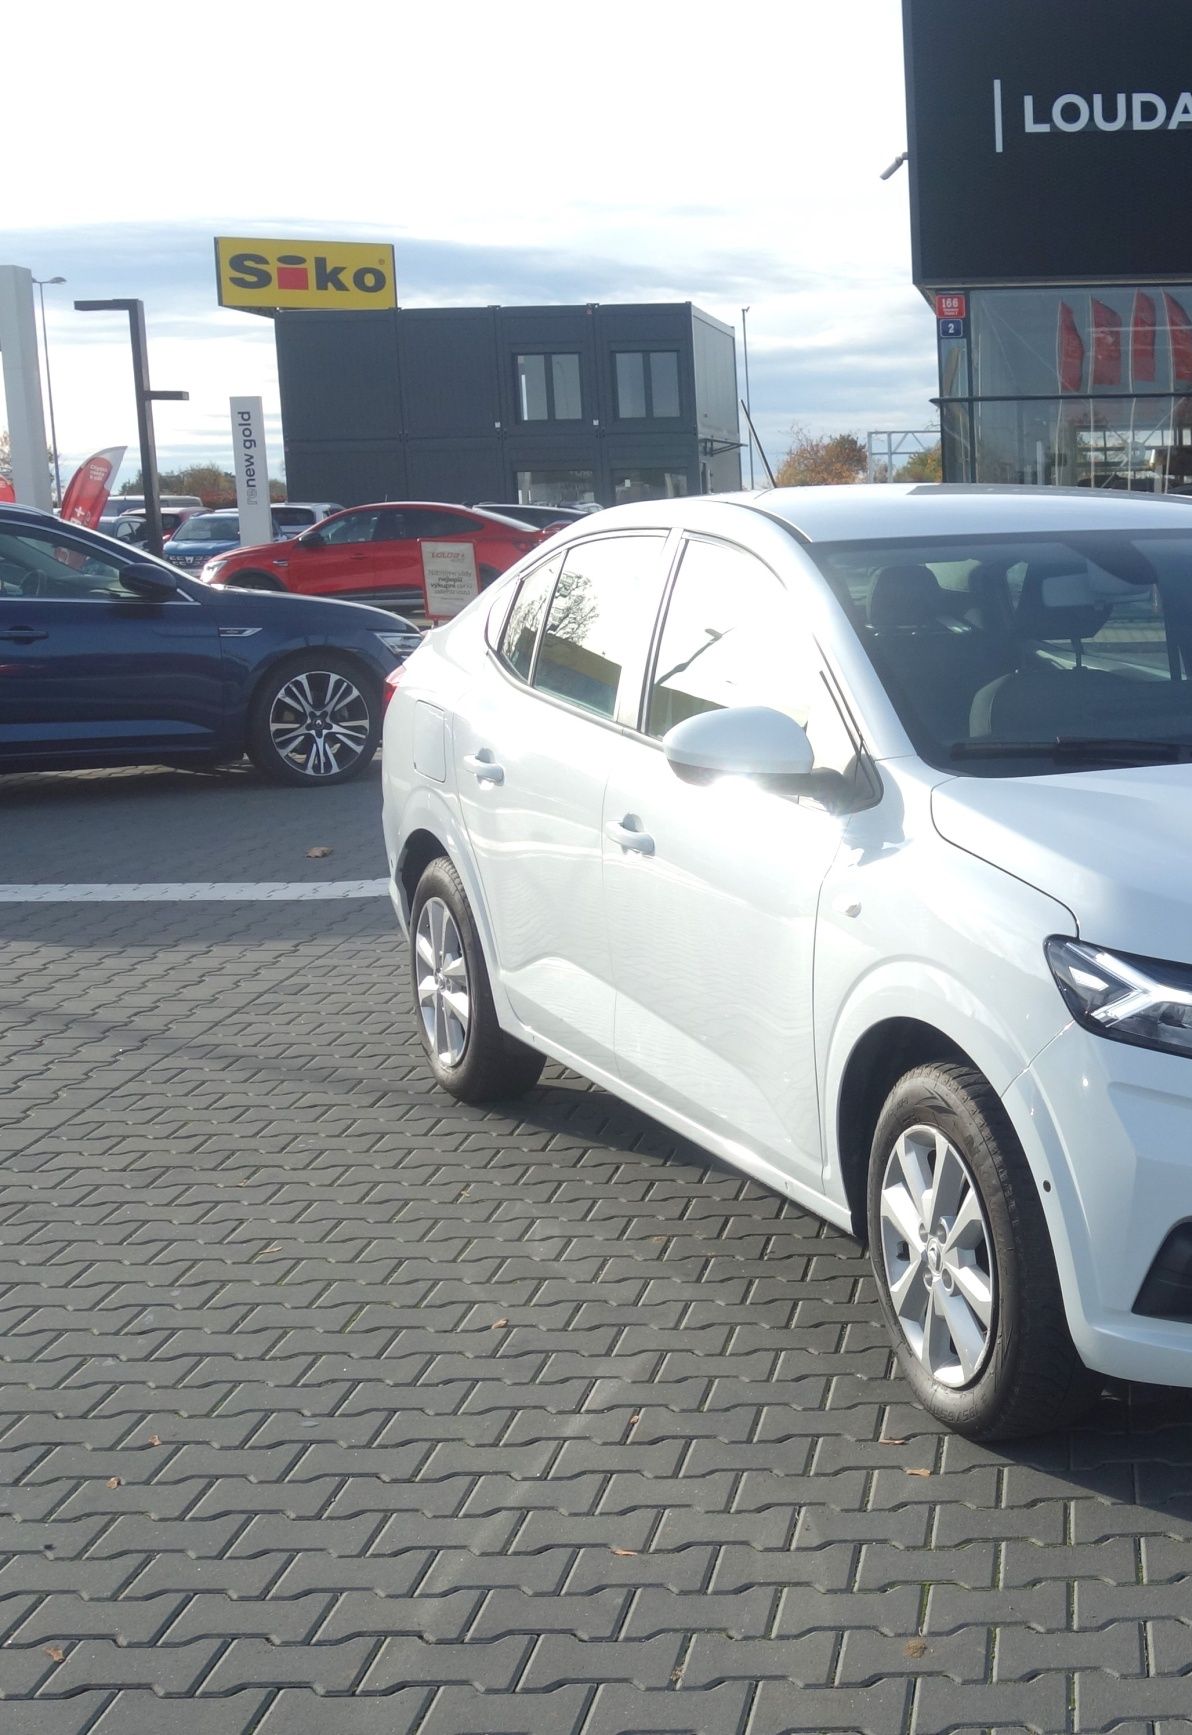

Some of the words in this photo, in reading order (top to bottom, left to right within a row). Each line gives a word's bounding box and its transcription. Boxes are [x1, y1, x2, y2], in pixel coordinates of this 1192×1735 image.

[229, 253, 386, 293] Siko
[942, 297, 959, 308] 166
[947, 323, 955, 334] 2
[237, 411, 256, 450] gold
[244, 453, 258, 506] renew
